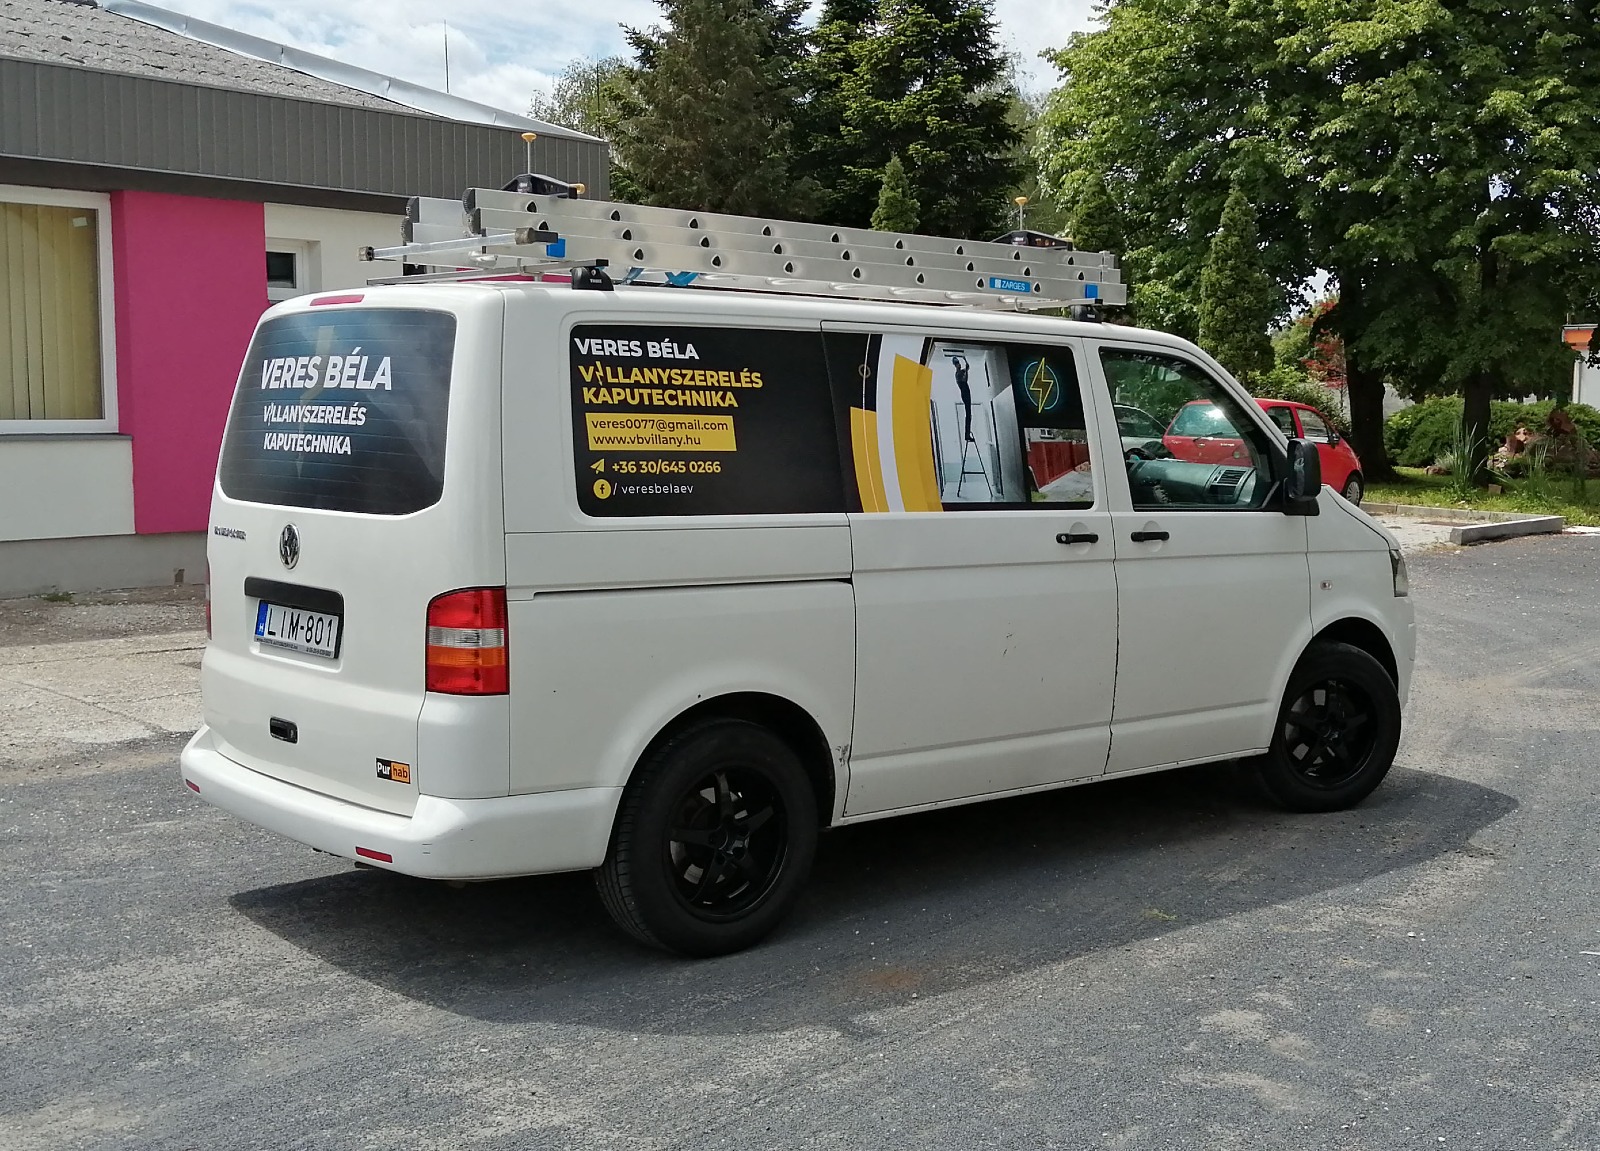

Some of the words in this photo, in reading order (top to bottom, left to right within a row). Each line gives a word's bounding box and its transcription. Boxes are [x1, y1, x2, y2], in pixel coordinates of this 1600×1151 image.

[1001, 280, 1025, 291] ZARGES
[574, 338, 643, 357] VERES
[646, 338, 700, 360] BÉLA
[261, 355, 322, 389] VERES
[323, 346, 392, 390] BÉLA
[578, 361, 763, 388] VILLANYSZERELÉS
[582, 387, 739, 407] KAPUTECHNIKA
[591, 419, 728, 432] veres0077@gmail.com
[263, 432, 351, 454] KAPUTECHNIKA
[593, 434, 701, 447] www.vbvillany.hu
[612, 461, 637, 474] +36
[640, 459, 686, 475] 30/645
[689, 461, 721, 474] 0266
[621, 483, 694, 494] veresbelaev
[267, 607, 333, 648] LIM-801
